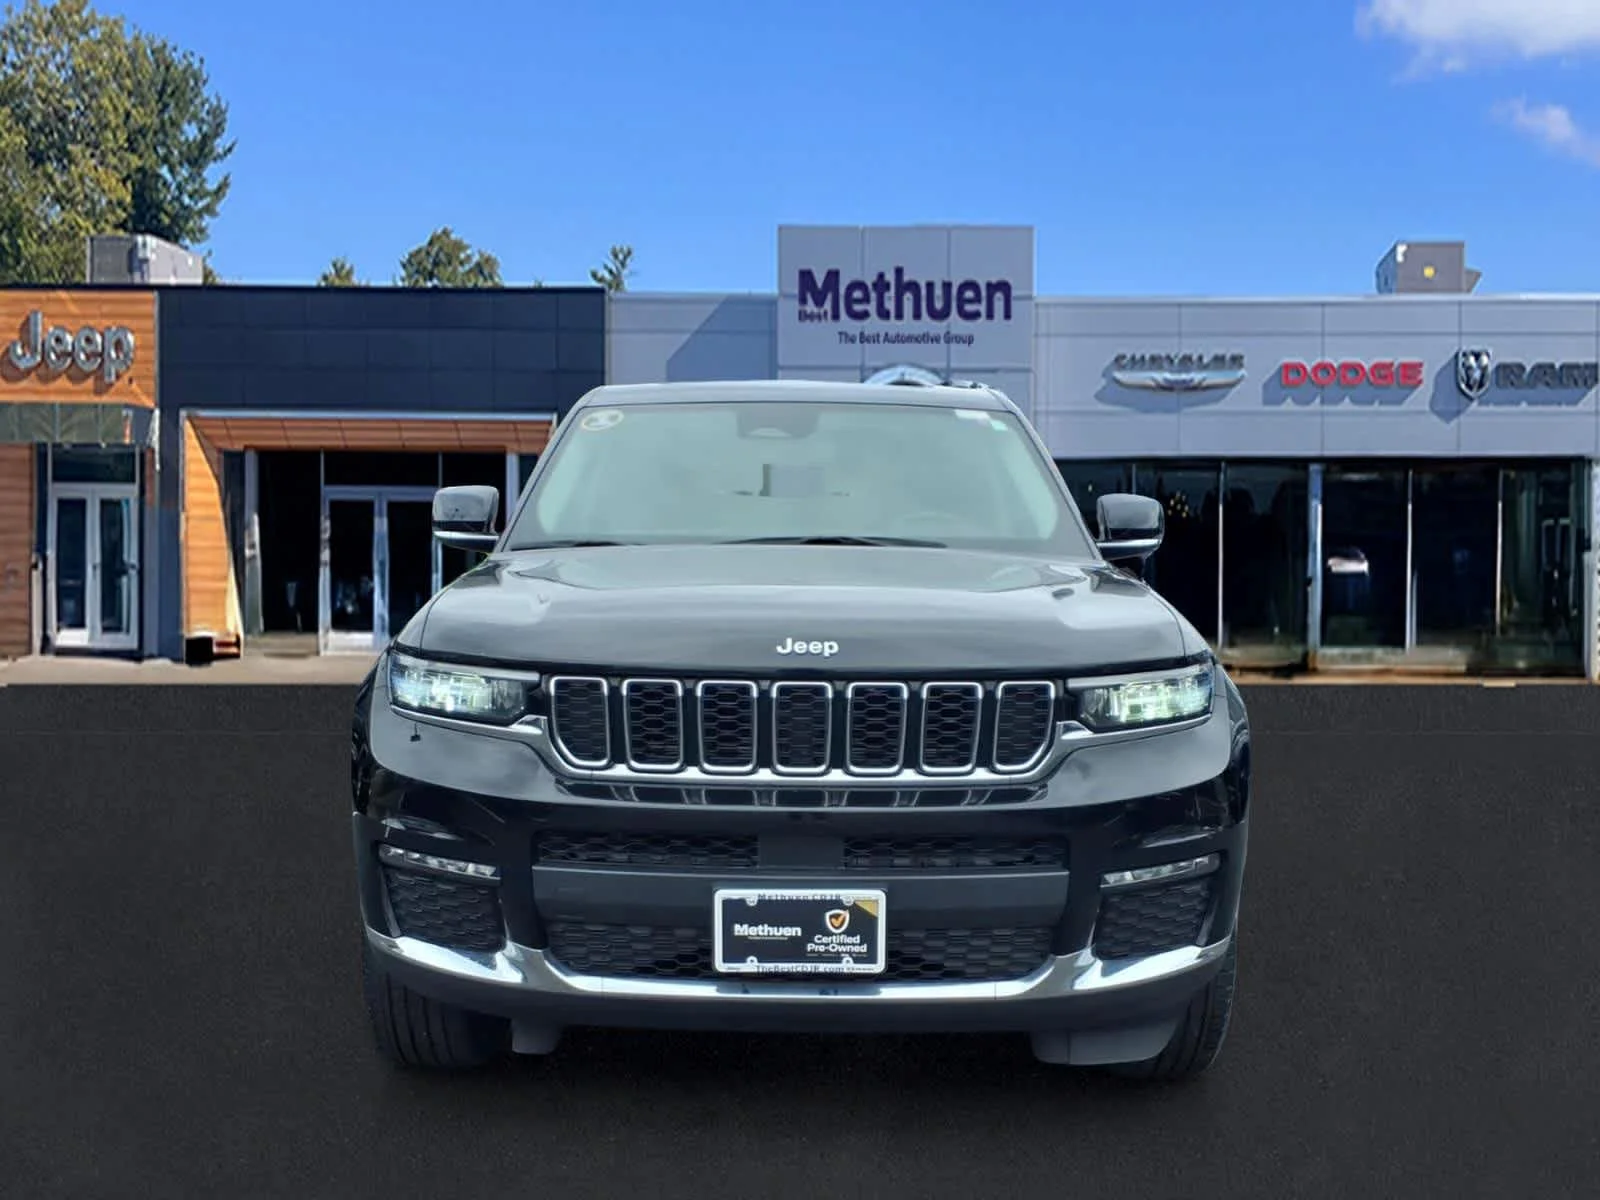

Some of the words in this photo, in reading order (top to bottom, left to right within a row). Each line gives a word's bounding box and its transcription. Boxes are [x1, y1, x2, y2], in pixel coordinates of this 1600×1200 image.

[798, 266, 1012, 321] Methuen
[798, 309, 829, 322] Best
[10, 310, 135, 383] Jeep
[838, 331, 857, 345] The
[859, 331, 880, 345] Best
[883, 331, 941, 345] Automotive
[943, 331, 974, 347] Group
[1114, 353, 1245, 371] CHRYSLER
[1281, 361, 1423, 387] DODGE
[1495, 362, 1599, 389] RAM
[776, 637, 839, 657] Jeep
[734, 924, 802, 936] Methuen
[807, 944, 868, 953] Pre-Owned
[814, 935, 860, 944] Certified
